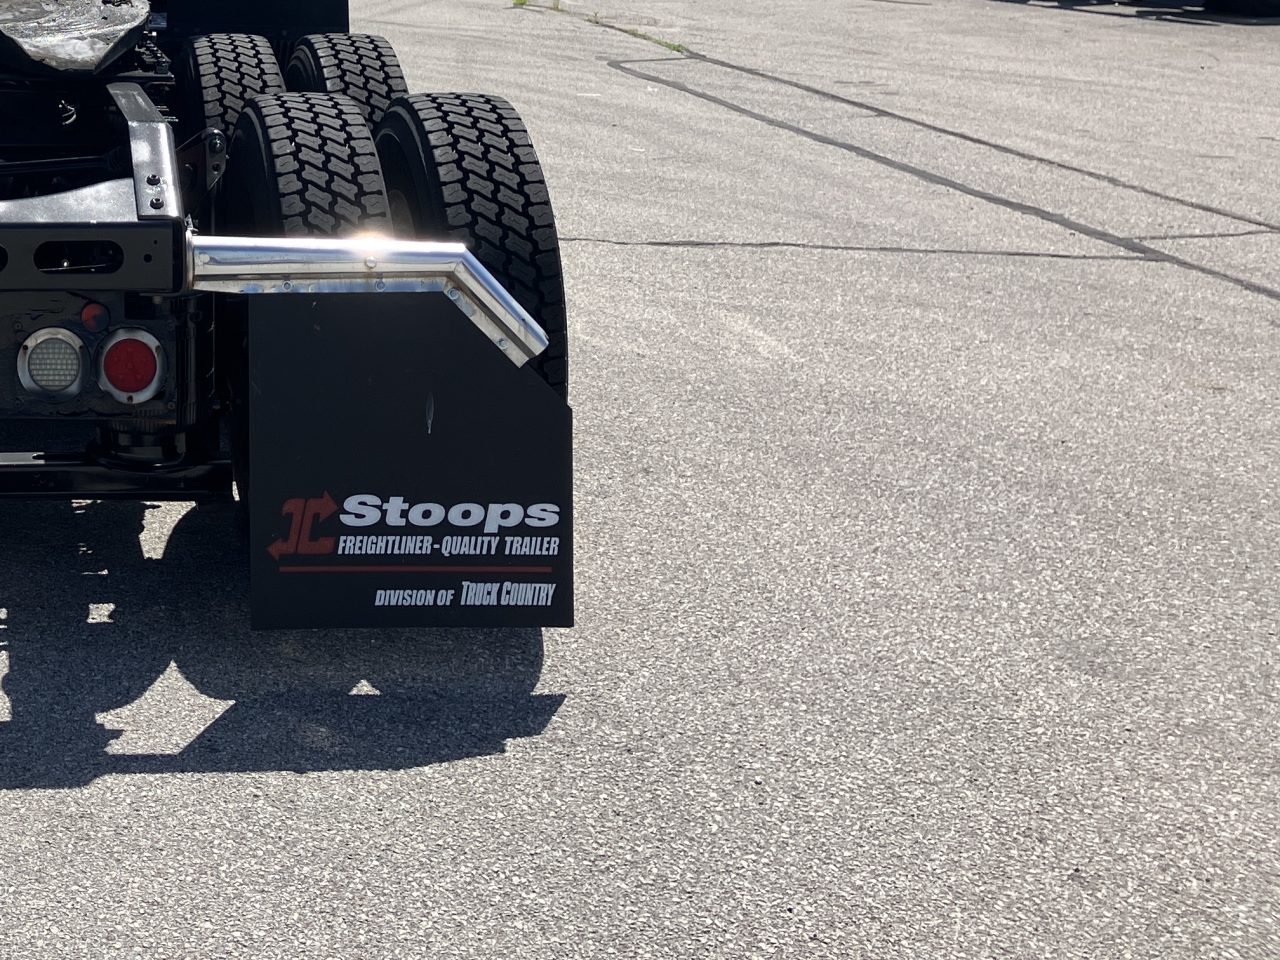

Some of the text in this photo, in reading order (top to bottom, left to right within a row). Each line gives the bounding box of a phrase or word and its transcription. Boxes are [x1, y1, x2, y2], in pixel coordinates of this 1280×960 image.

[339, 494, 561, 534] Stoops
[504, 536, 560, 556] TRAILER
[374, 589, 435, 606] DIVISION
[437, 589, 455, 606] OF
